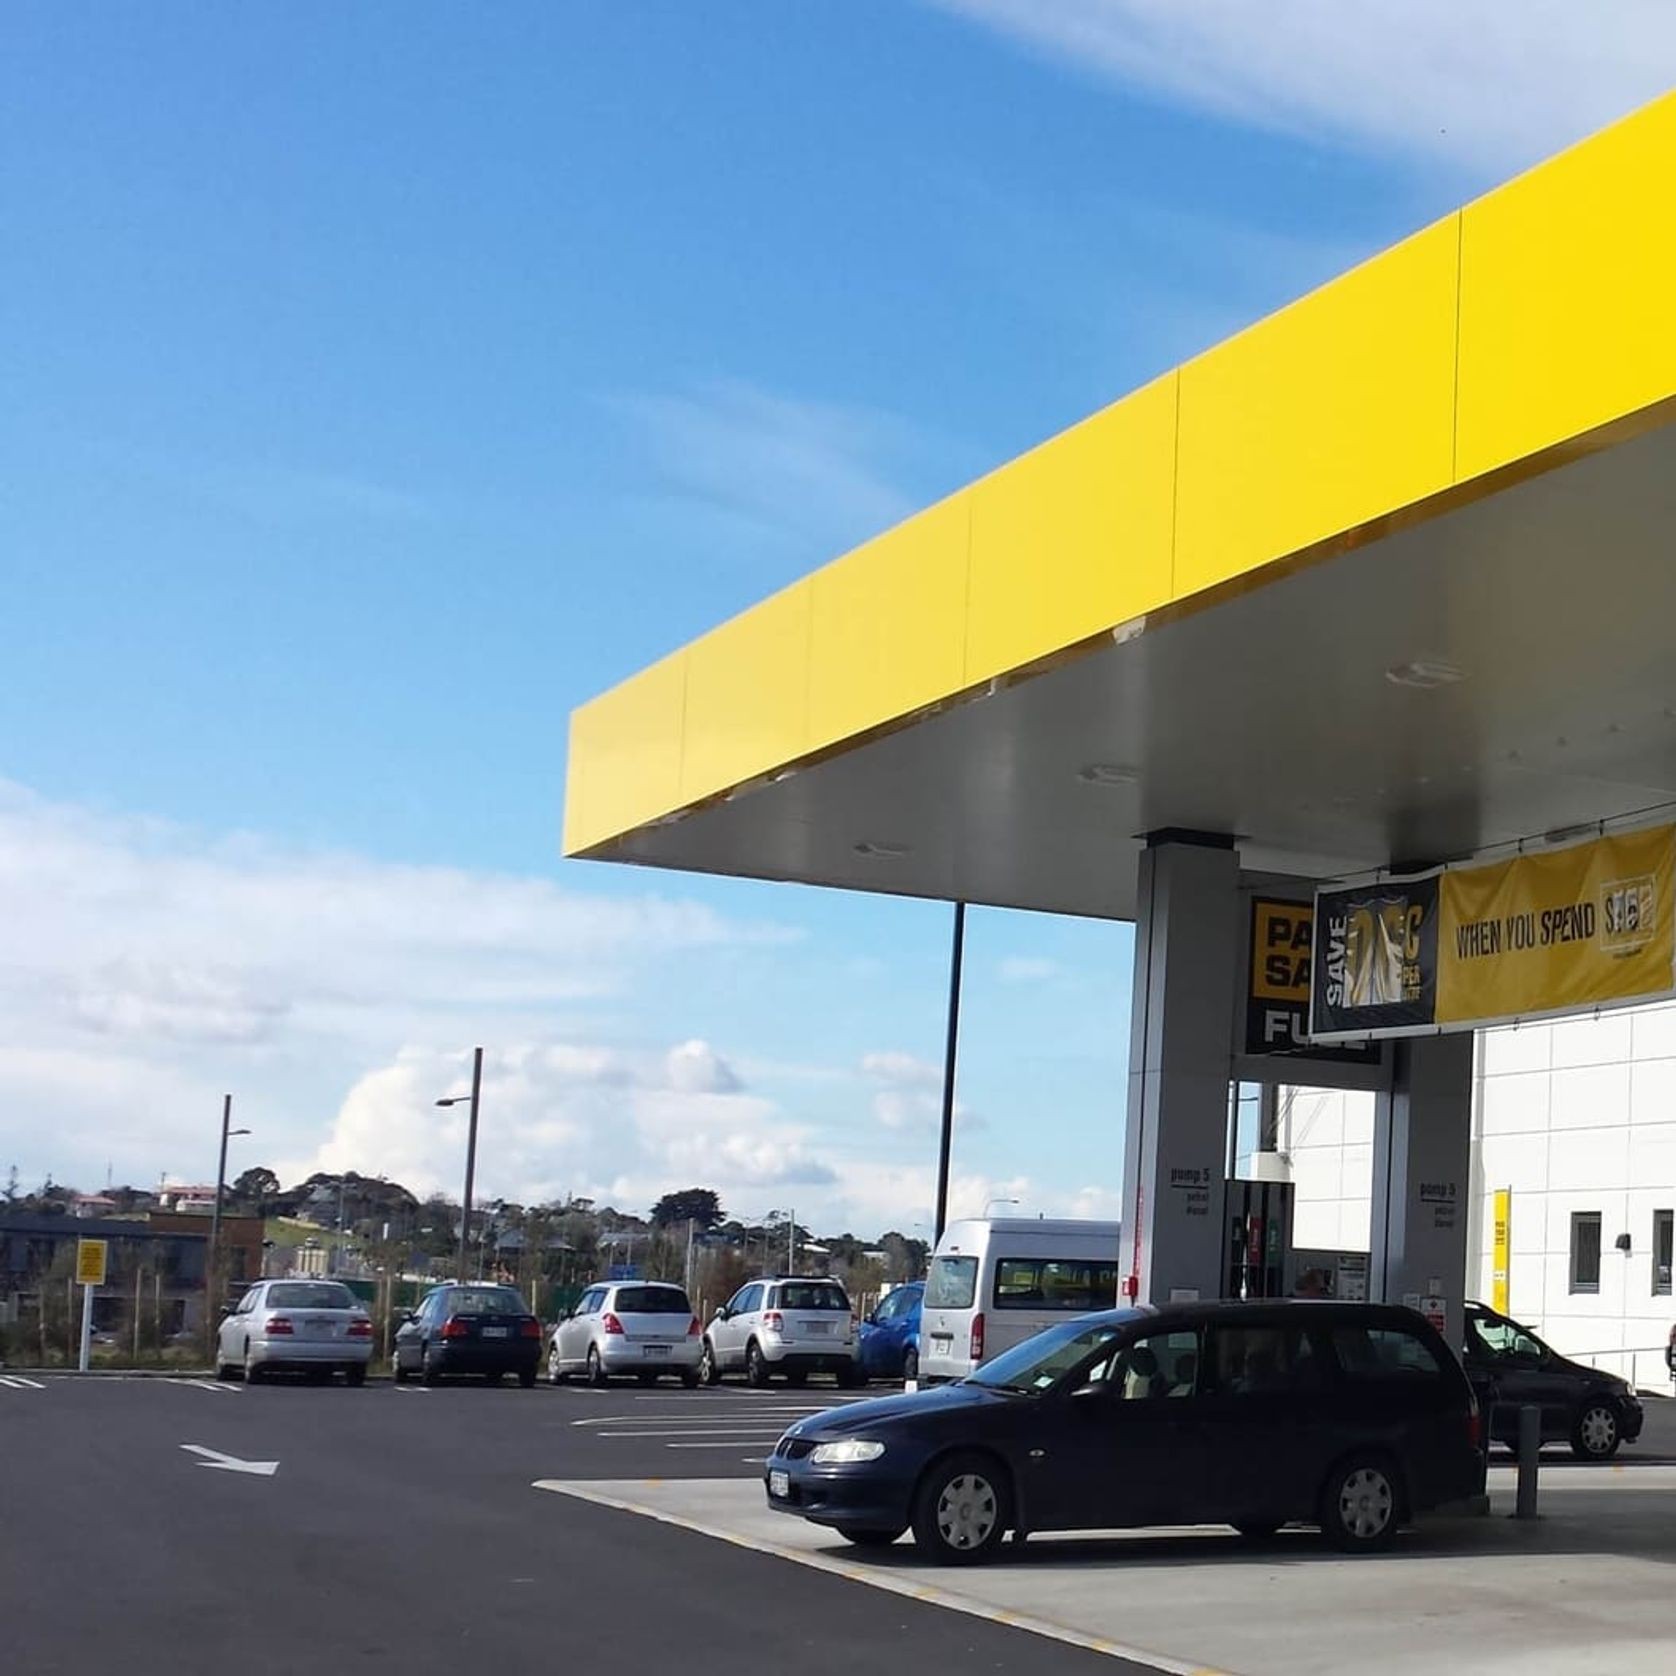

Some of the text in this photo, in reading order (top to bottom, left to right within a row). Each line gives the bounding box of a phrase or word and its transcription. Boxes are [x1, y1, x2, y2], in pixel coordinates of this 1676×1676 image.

[1268, 916, 1312, 951] PA
[1456, 919, 1501, 960] WHEN
[1506, 913, 1535, 951] YOU
[1540, 902, 1596, 946] SPEND
[1265, 954, 1311, 988] SA
[1326, 915, 1347, 1007] SAVE
[1171, 1167, 1210, 1184] pump 5
